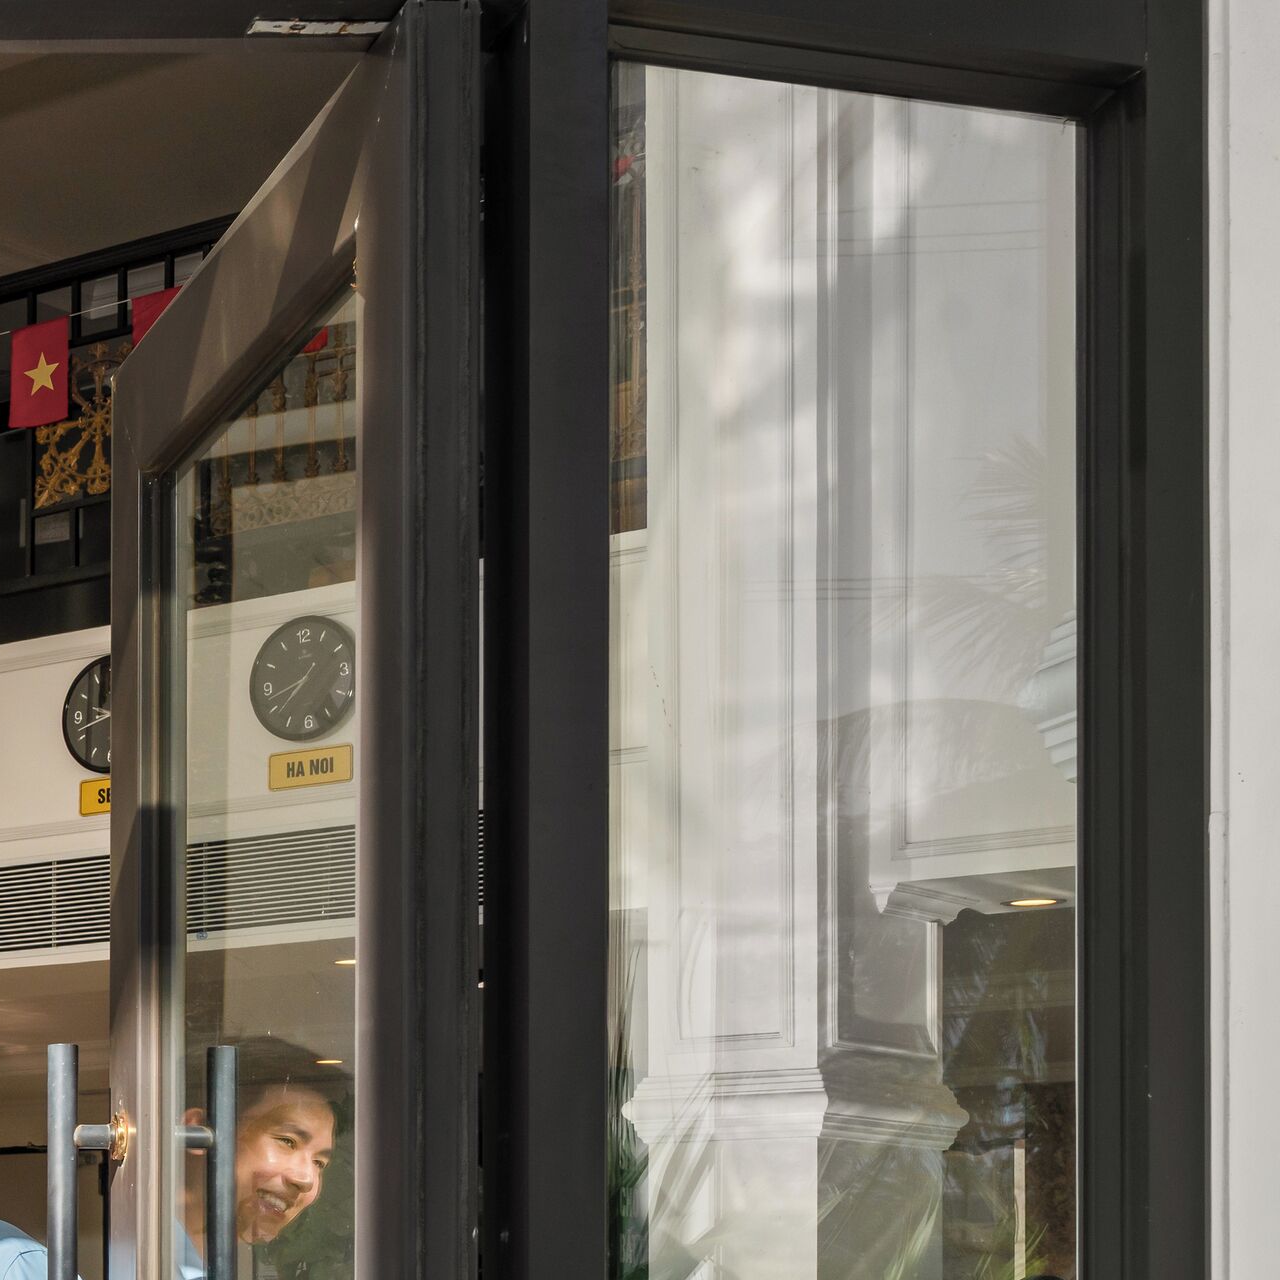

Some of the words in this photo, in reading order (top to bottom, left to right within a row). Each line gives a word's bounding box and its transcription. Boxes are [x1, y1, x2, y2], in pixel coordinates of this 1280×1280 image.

[296, 628, 311, 644] 12
[339, 662, 349, 676] 3
[263, 682, 273, 696] 9
[74, 710, 83, 724] 9
[304, 714, 313, 729] 6
[286, 761, 306, 779] HA
[309, 757, 334, 776] NOI
